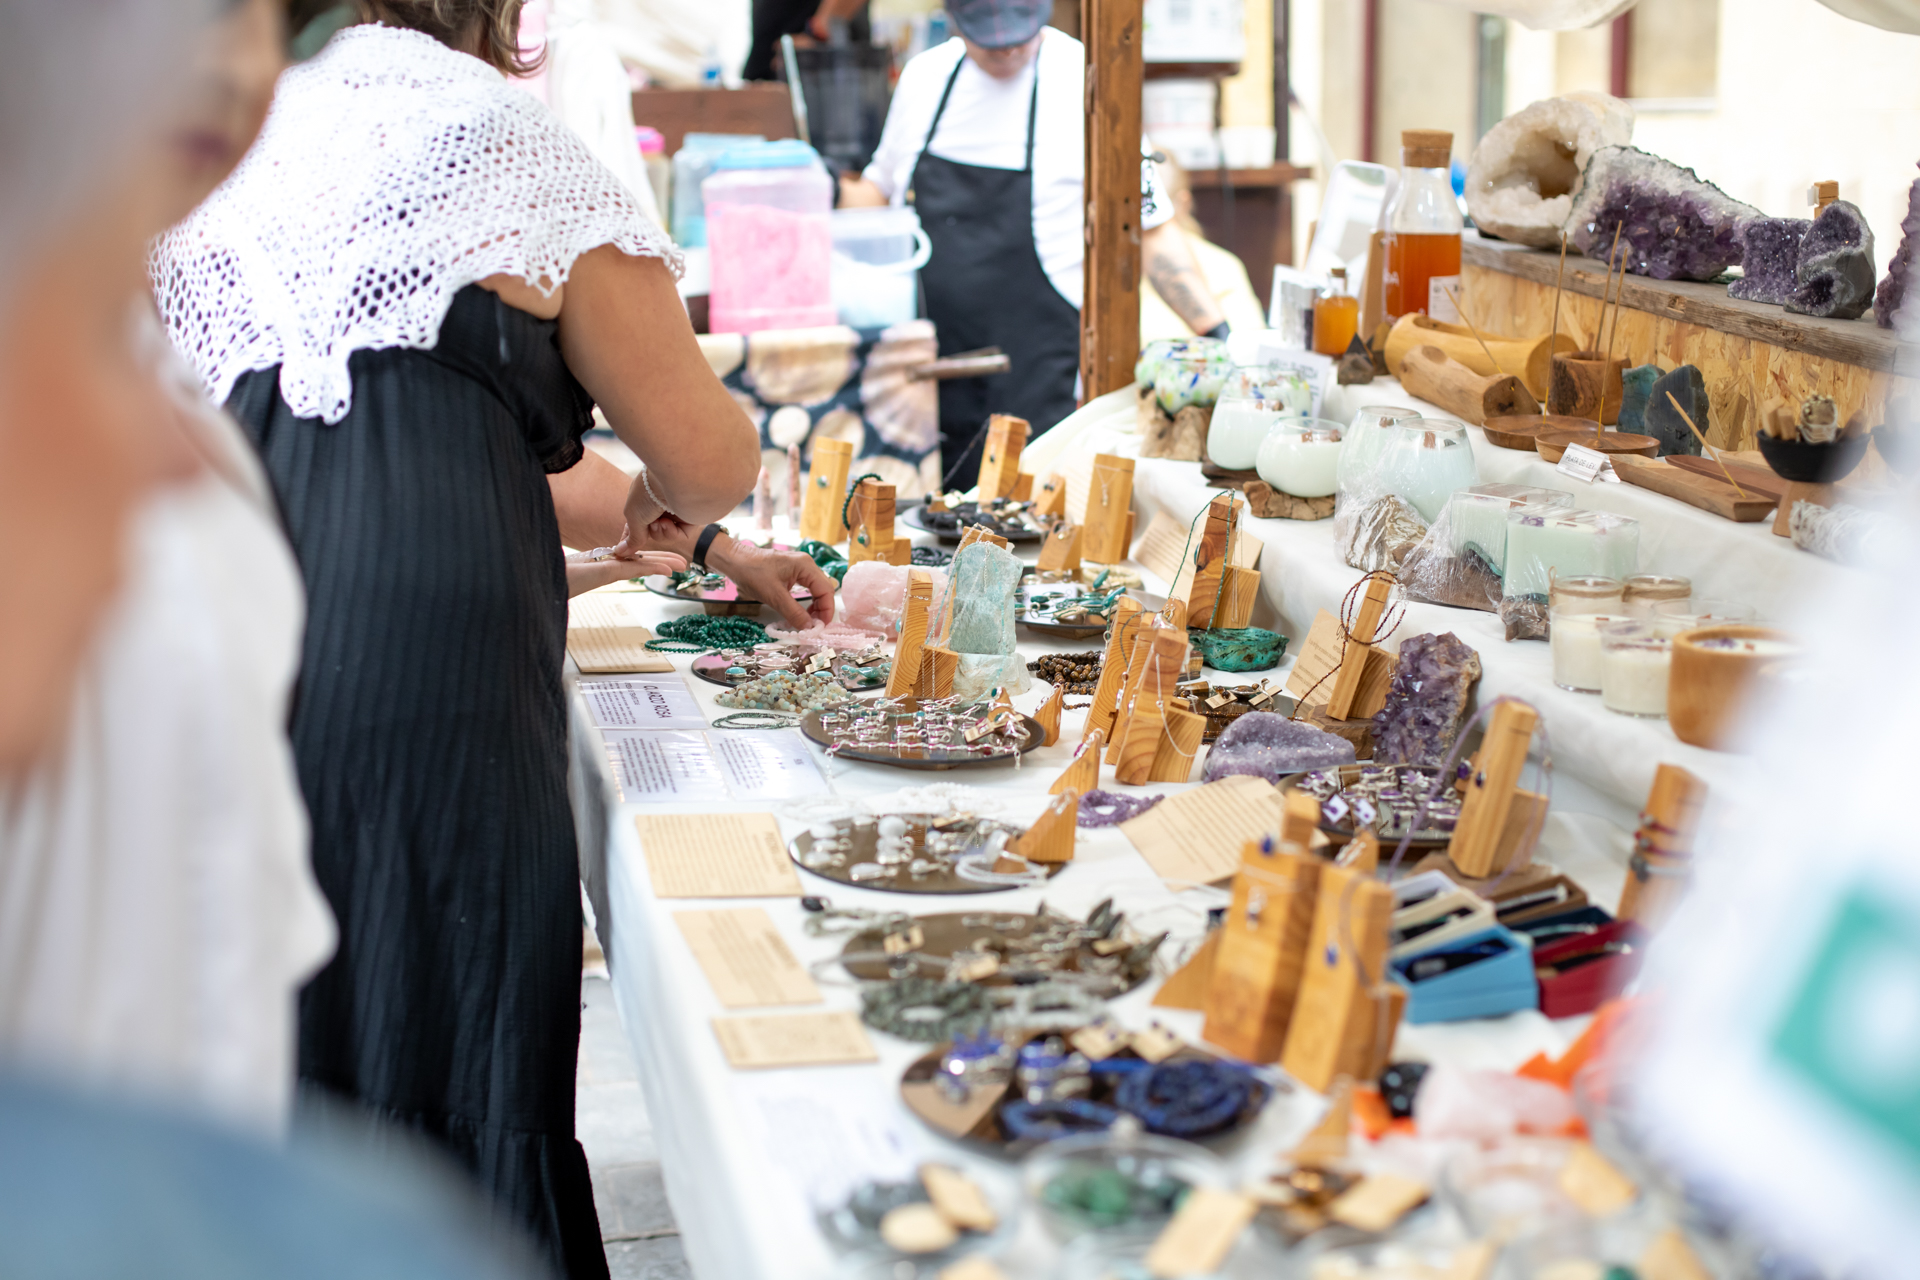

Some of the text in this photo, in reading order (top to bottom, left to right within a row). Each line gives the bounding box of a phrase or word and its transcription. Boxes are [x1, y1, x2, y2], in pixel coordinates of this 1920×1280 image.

[1565, 454, 1596, 470] PLATA DE LEY
[653, 704, 673, 719] ROSA
